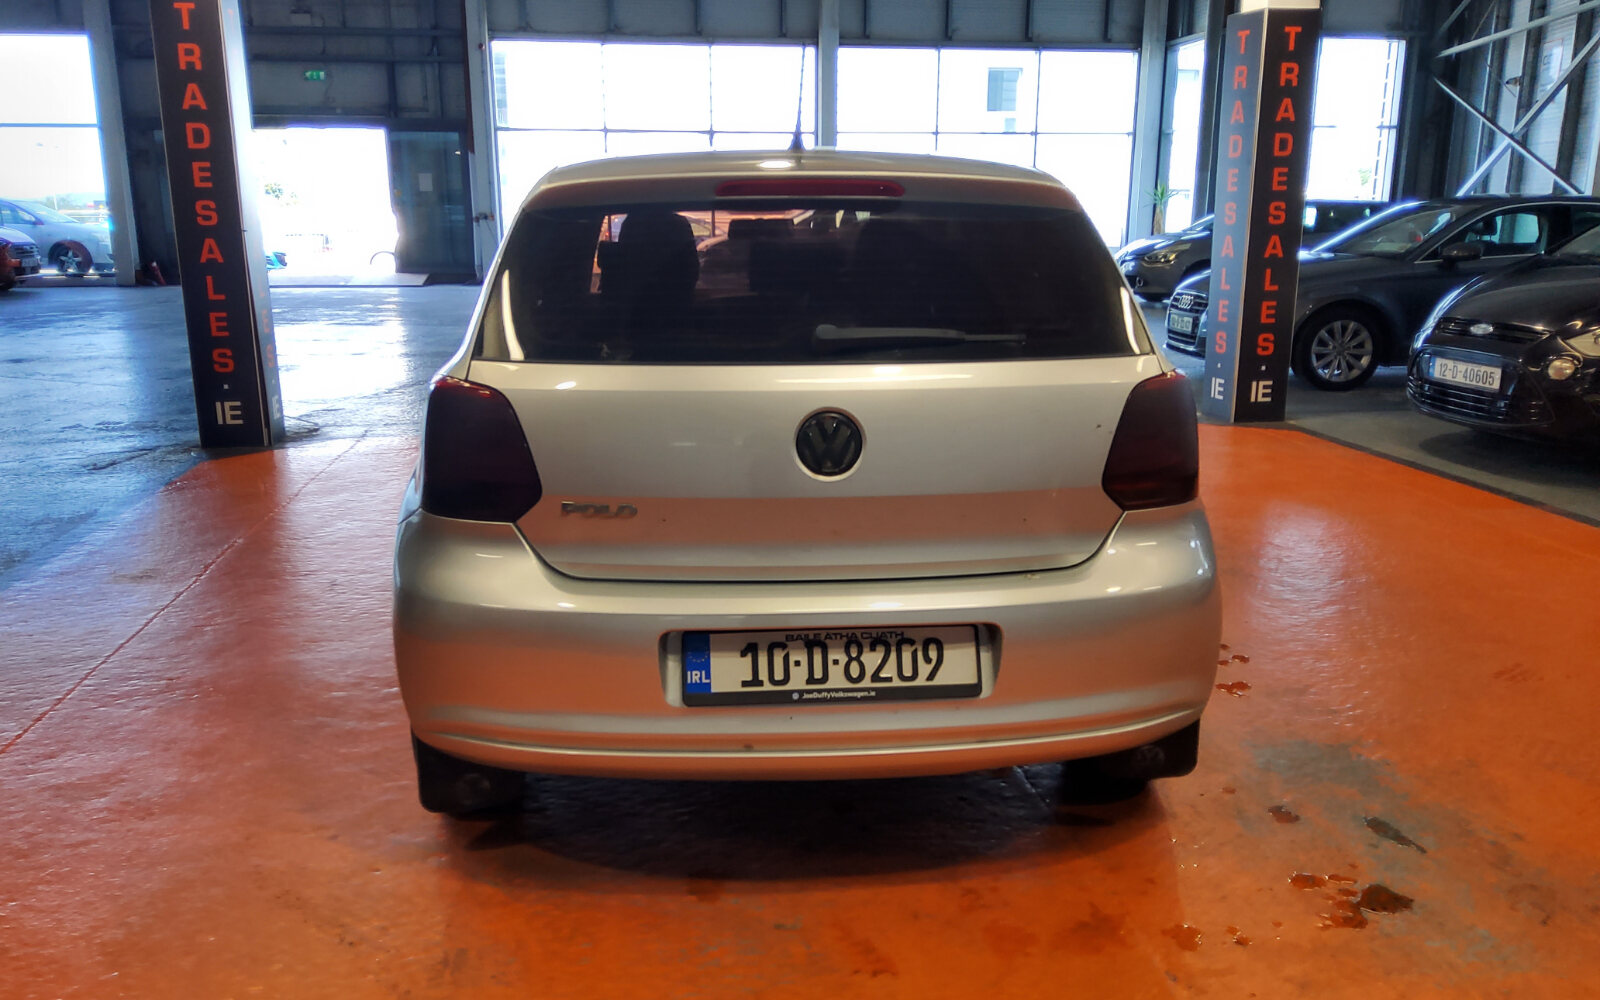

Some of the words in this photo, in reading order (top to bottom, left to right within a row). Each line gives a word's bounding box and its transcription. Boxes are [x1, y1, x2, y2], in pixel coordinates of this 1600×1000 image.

[560, 500, 638, 518] POLO
[785, 632, 822, 642] BAILE
[687, 670, 711, 684] IRL
